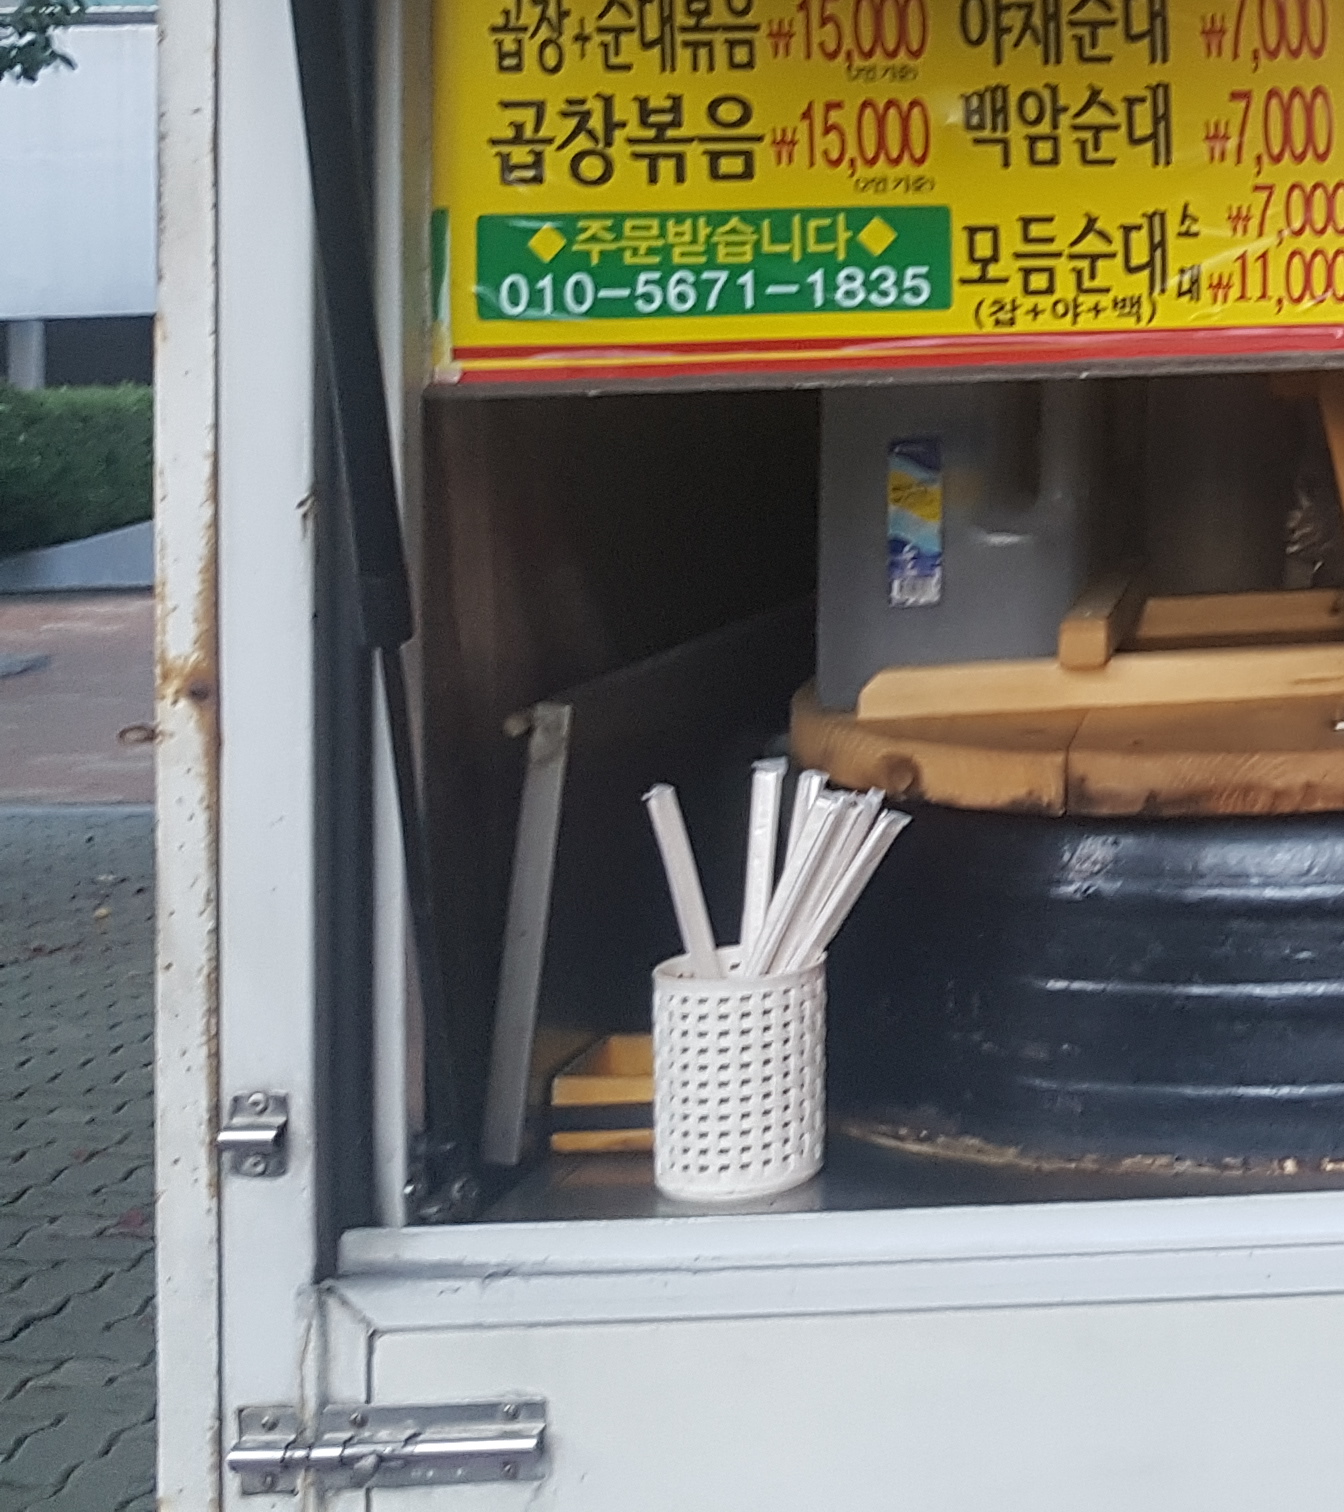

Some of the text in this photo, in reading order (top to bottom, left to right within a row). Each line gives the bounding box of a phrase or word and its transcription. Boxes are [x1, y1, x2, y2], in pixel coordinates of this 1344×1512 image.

[489, 92, 765, 188] 곱창볶음
[959, 81, 1174, 170] 백암순대
[571, 211, 853, 267] 주문받습니다
[958, 209, 1170, 297] 모듬순대
[1176, 202, 1200, 239] 소
[498, 265, 933, 317] 010-5671-1835
